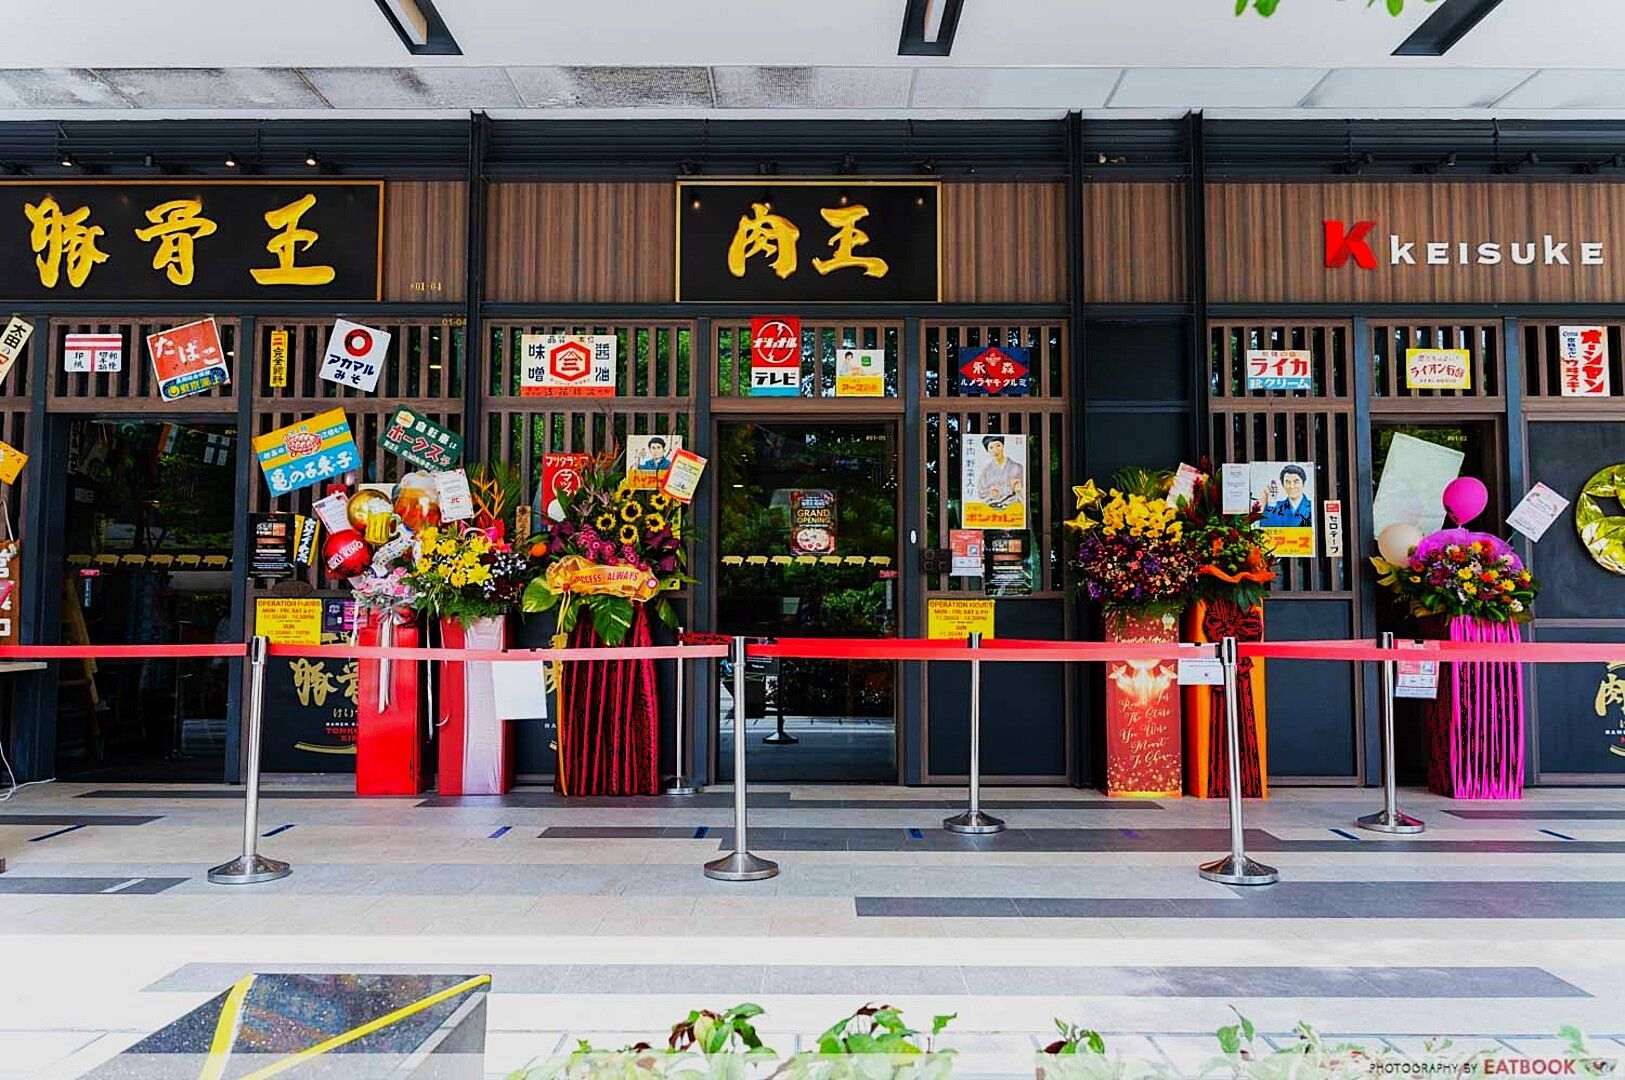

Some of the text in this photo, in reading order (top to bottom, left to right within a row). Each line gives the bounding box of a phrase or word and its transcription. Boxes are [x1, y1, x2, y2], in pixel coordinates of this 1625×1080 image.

[24, 193, 336, 289] 豚骨王
[727, 202, 888, 279] 肉王
[1389, 234, 1604, 265] KEISUKE
[155, 336, 220, 365] たばこ
[328, 354, 375, 376] アカマル
[528, 344, 545, 382] 味噌
[1251, 358, 1308, 377] ライカ
[334, 370, 362, 384] みそ
[755, 371, 796, 385] テレビ
[797, 509, 830, 517] GRAND
[607, 570, 639, 581] ALWAYS
[333, 708, 358, 718] けい
